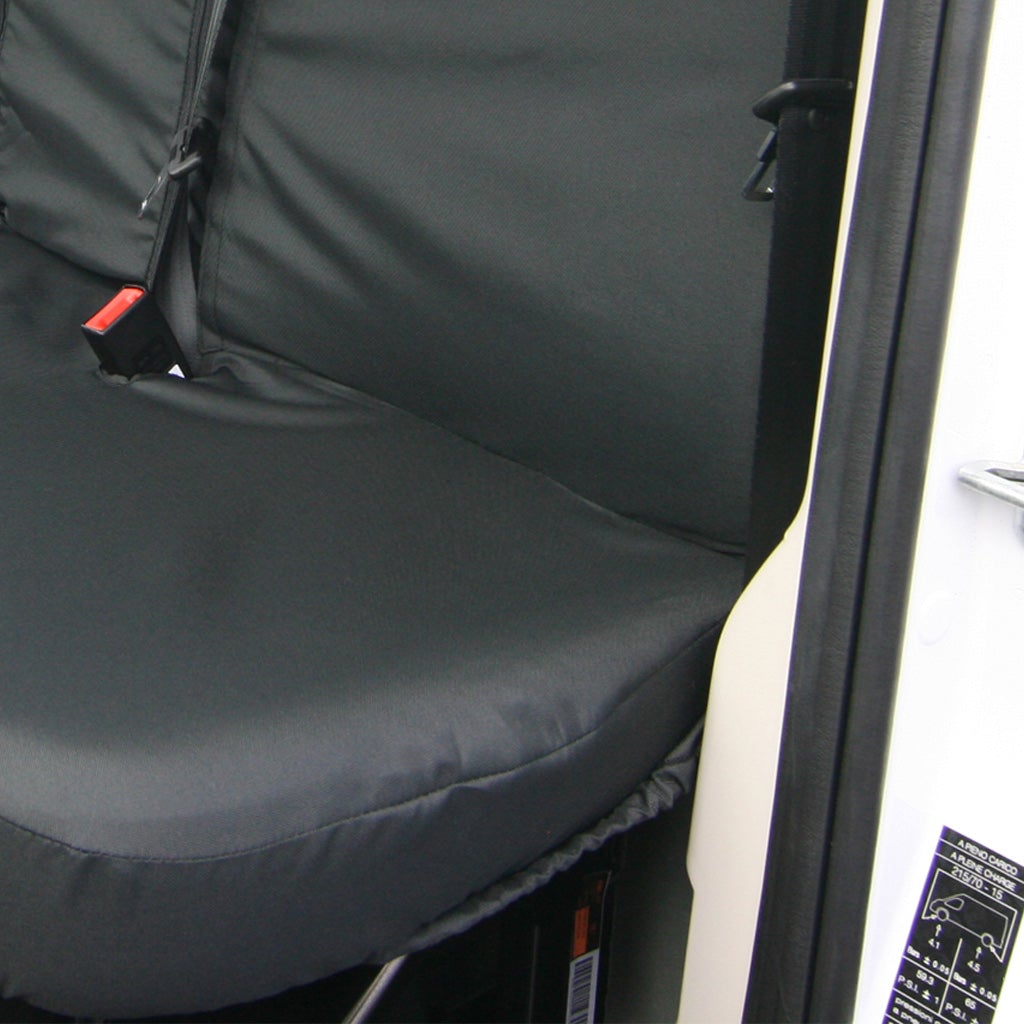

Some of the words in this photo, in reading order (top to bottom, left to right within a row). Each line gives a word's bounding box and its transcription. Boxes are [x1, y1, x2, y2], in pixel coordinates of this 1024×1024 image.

[950, 851, 958, 860] A
[984, 869, 1016, 891] CHARGE
[957, 840, 964, 848] A
[988, 855, 1018, 875] CARICO
[951, 866, 983, 888] 215/70
[992, 888, 1003, 900] 15
[964, 997, 977, 1010] 65
